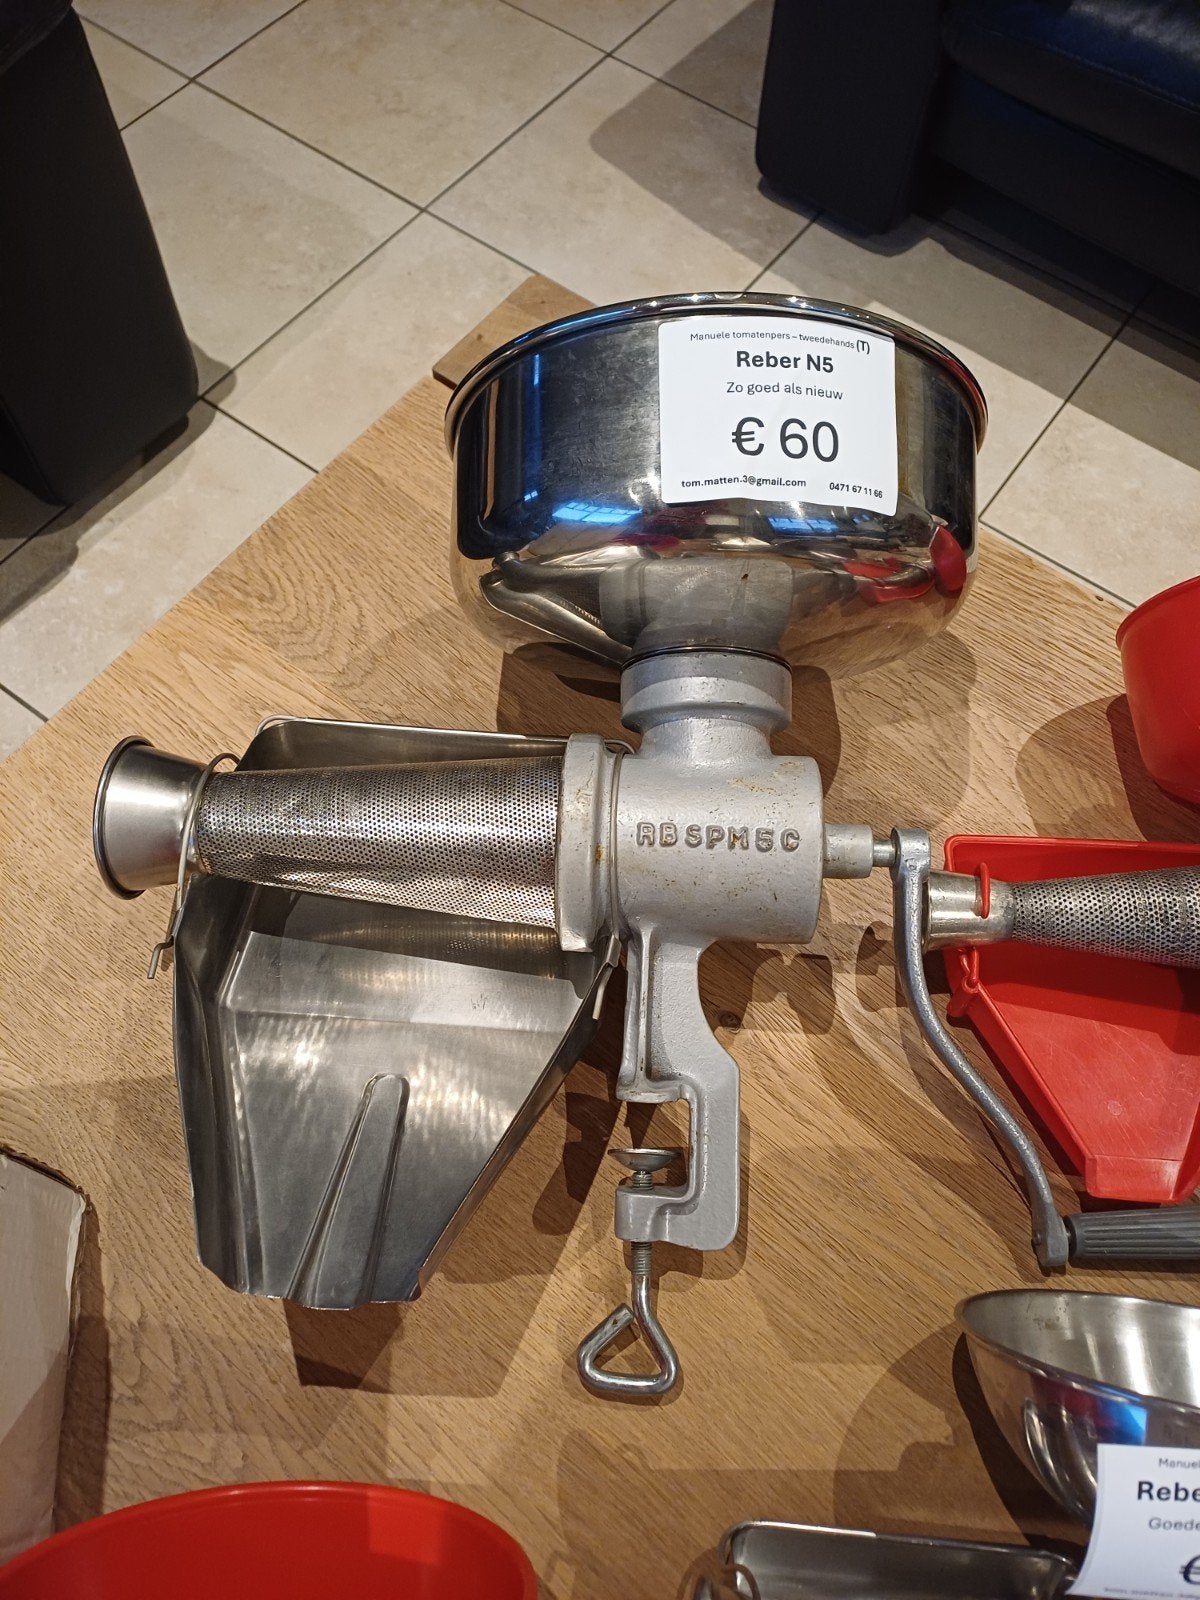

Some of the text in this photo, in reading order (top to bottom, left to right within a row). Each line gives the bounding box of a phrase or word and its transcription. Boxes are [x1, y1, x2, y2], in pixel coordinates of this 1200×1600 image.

[690, 331, 731, 342] Manuele
[732, 331, 791, 341] tomatenpers
[799, 334, 855, 349] tweedehands
[856, 339, 871, 355] (T)
[736, 350, 834, 373] Reber N5
[726, 381, 843, 400] Zo goed als nieuw
[731, 416, 839, 463] € 60
[681, 475, 807, 488] tom.matten.3@gmail.com
[829, 482, 883, 499] 0471 67 11 66
